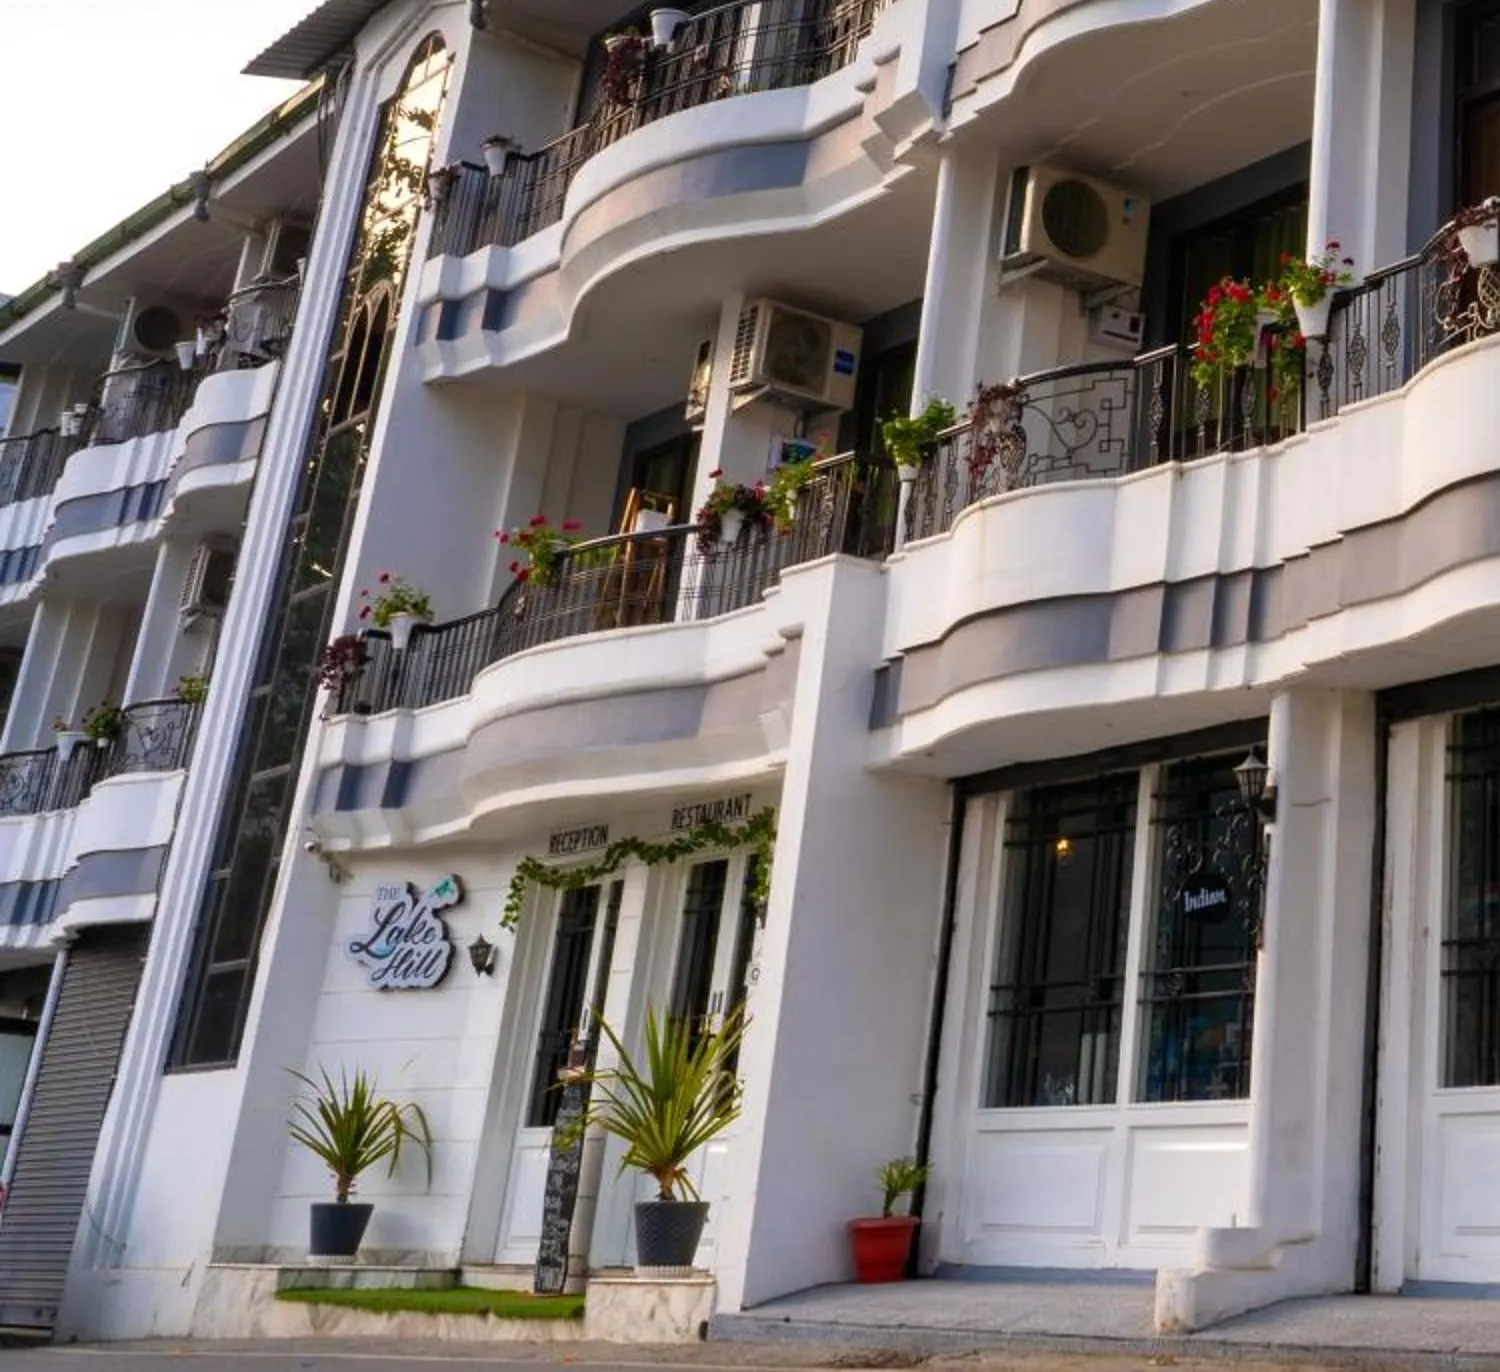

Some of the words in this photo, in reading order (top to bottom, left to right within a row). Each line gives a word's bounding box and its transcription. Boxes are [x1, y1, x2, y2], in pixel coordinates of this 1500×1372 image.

[671, 793, 752, 829] RESTAURANT
[549, 823, 609, 854] RECEPTION
[376, 886, 401, 901] THE
[1183, 887, 1228, 913] Indian
[350, 901, 437, 960] Lake
[371, 947, 442, 981] Hill
